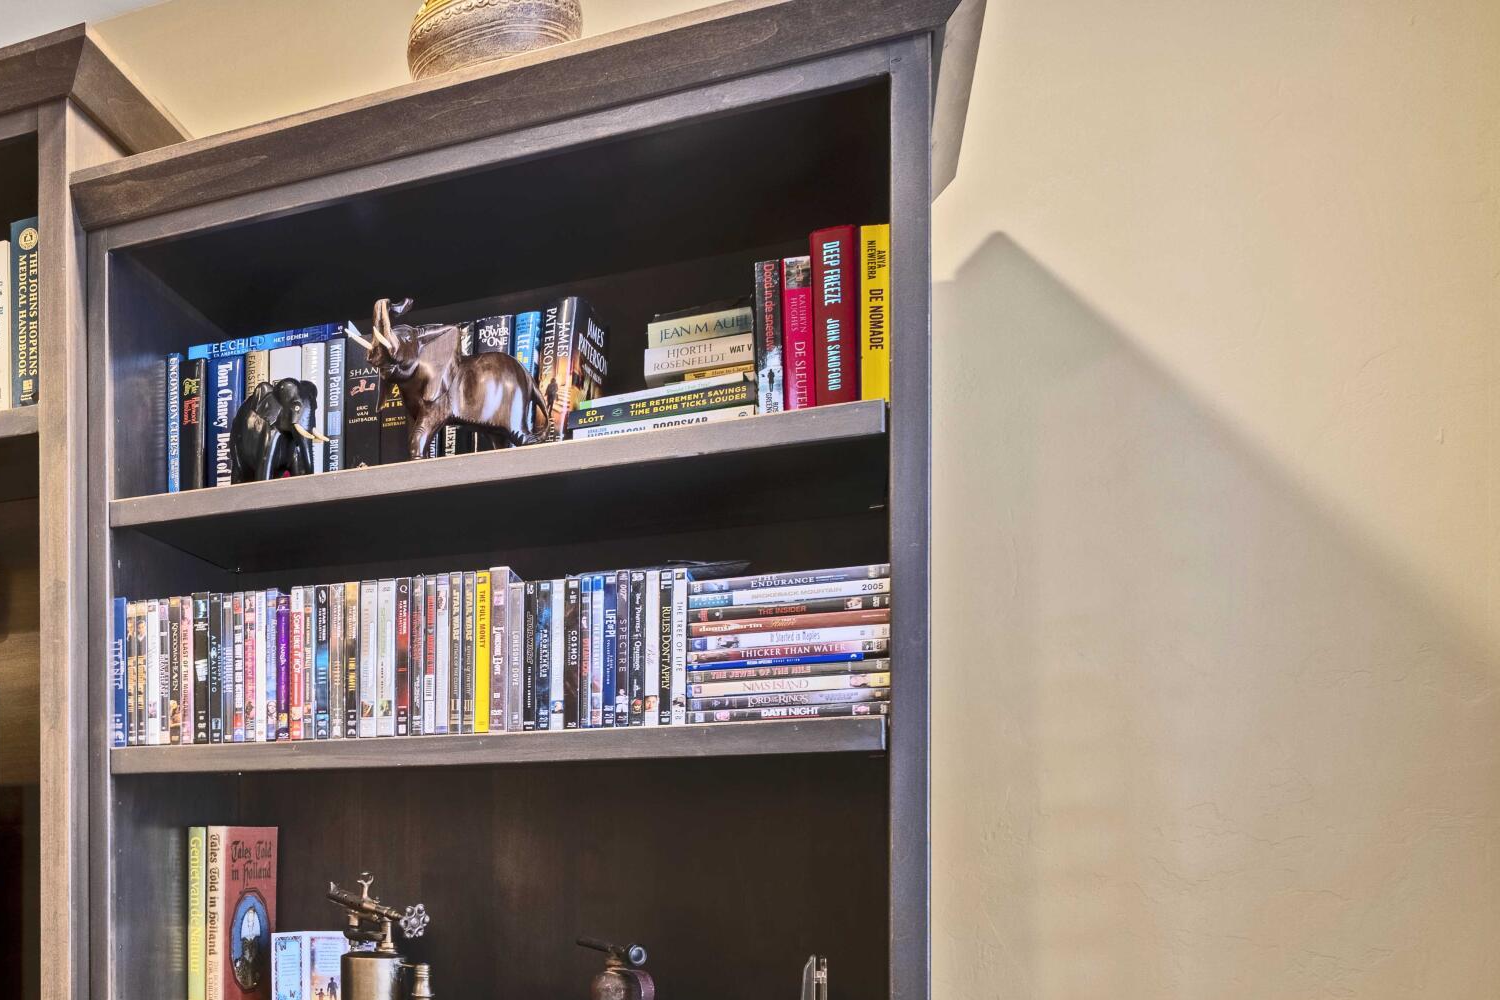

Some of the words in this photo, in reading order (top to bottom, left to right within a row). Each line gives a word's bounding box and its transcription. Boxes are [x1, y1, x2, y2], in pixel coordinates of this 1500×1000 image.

[29, 251, 38, 276] THE
[823, 240, 840, 266] DEEP
[867, 240, 877, 280] NIEWIERRA
[876, 250, 886, 269] ANYA
[18, 255, 27, 307] MEDICAL
[764, 263, 775, 288] Dood
[824, 268, 842, 306] FREEZE
[28, 279, 38, 317] JOHNS
[765, 290, 776, 300] in
[766, 301, 777, 313] de
[869, 288, 884, 302] DE
[790, 297, 799, 332] HUGHES
[798, 294, 808, 333] KATHRYN
[286, 332, 309, 342] GEHEIM
[479, 326, 509, 340] POWER
[557, 321, 571, 357] JAMES
[586, 317, 605, 348] JAMES
[660, 325, 691, 343] JEAN
[713, 314, 751, 332] AUEL
[766, 314, 776, 352] sneeuw
[826, 318, 840, 342] JOHN
[869, 305, 884, 350] NOMADE
[18, 310, 27, 378] HANDBOOK
[28, 321, 38, 376] HOPKINS
[206, 343, 227, 355] LEE
[228, 335, 265, 351] CHILD
[486, 336, 508, 347] ONE
[542, 307, 558, 374] PATTERSON
[667, 343, 713, 359] HJORTH
[729, 344, 745, 354] WAT
[794, 341, 806, 358] DE
[329, 344, 342, 375] Killing
[578, 332, 608, 377] PATTERSON
[653, 352, 726, 371] ROSENFELDT
[217, 362, 232, 387] Tom
[349, 367, 379, 377] SHAN
[828, 345, 842, 391] SANDFORD
[169, 357, 178, 420] UNCOMMON
[329, 376, 341, 407] Patton
[630, 401, 647, 410] THE
[649, 392, 704, 406] RETIREMENT
[707, 385, 747, 397] SAVINGS
[213, 388, 232, 428] Clancy
[629, 408, 650, 417] TIME
[653, 404, 679, 413] BOMB
[681, 399, 707, 409] TICKS
[710, 393, 747, 404] LOUDER
[348, 416, 378, 424] LUSTBADER
[578, 415, 605, 425] SLOTT
[170, 422, 179, 456] CURES
[217, 432, 231, 462] Debt
[329, 439, 339, 454] BILL
[217, 463, 231, 474] of
[750, 576, 815, 588] ENDURANCE
[861, 582, 884, 591] 2005
[452, 590, 460, 613] STAR
[465, 589, 473, 614] STAR
[758, 608, 774, 616] THE
[606, 609, 616, 624] LIFE
[662, 606, 671, 633] RULES
[493, 626, 504, 657] LONESOME
[619, 619, 627, 672] SPECTRE
[662, 635, 671, 662] DON'T
[676, 642, 683, 653] OF
[740, 649, 781, 659] THICKER
[784, 647, 812, 656] THAN
[815, 643, 846, 653] WATER
[182, 660, 189, 668] OF
[493, 657, 504, 675] DOVE
[662, 664, 670, 690] APPLY
[747, 696, 771, 708] LORD
[760, 708, 787, 718] DATE
[788, 706, 820, 716] NIGHT
[190, 836, 203, 882] Geniet
[209, 833, 221, 864] Tales
[231, 840, 251, 862] Tales
[255, 840, 272, 859] Told
[209, 867, 221, 892] Told
[231, 863, 239, 881] in
[242, 860, 271, 887] Holland
[190, 883, 202, 910] van
[209, 896, 220, 908] in
[190, 912, 203, 928] de
[208, 910, 220, 956] Holland
[190, 928, 203, 975] Natuur
